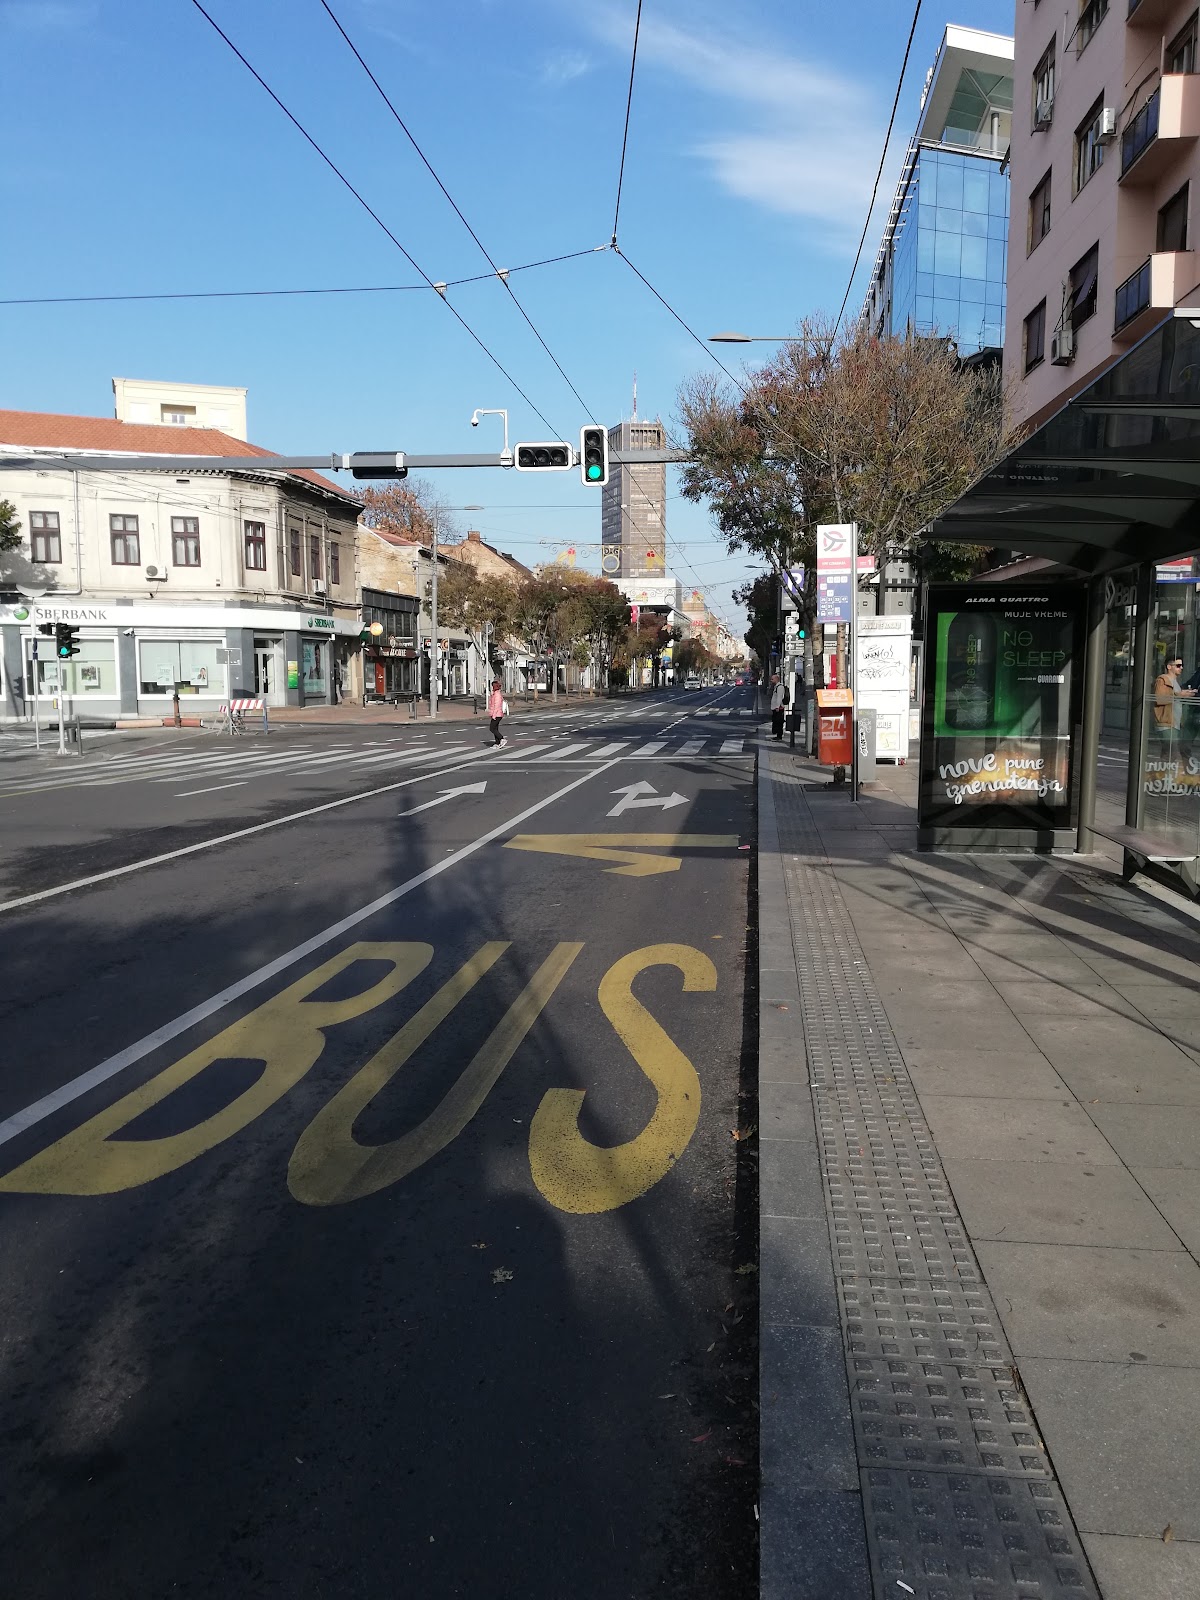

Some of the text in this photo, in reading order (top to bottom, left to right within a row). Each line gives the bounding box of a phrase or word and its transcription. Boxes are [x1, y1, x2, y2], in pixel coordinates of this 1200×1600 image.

[1114, 583, 1137, 607] Ban
[36, 608, 107, 620] SBERBANK
[1003, 630, 1033, 647] NO
[1002, 651, 1066, 667] SLEEP
[822, 718, 847, 737] 24
[1005, 758, 1045, 776] pune
[0, 941, 717, 1214] BUS
